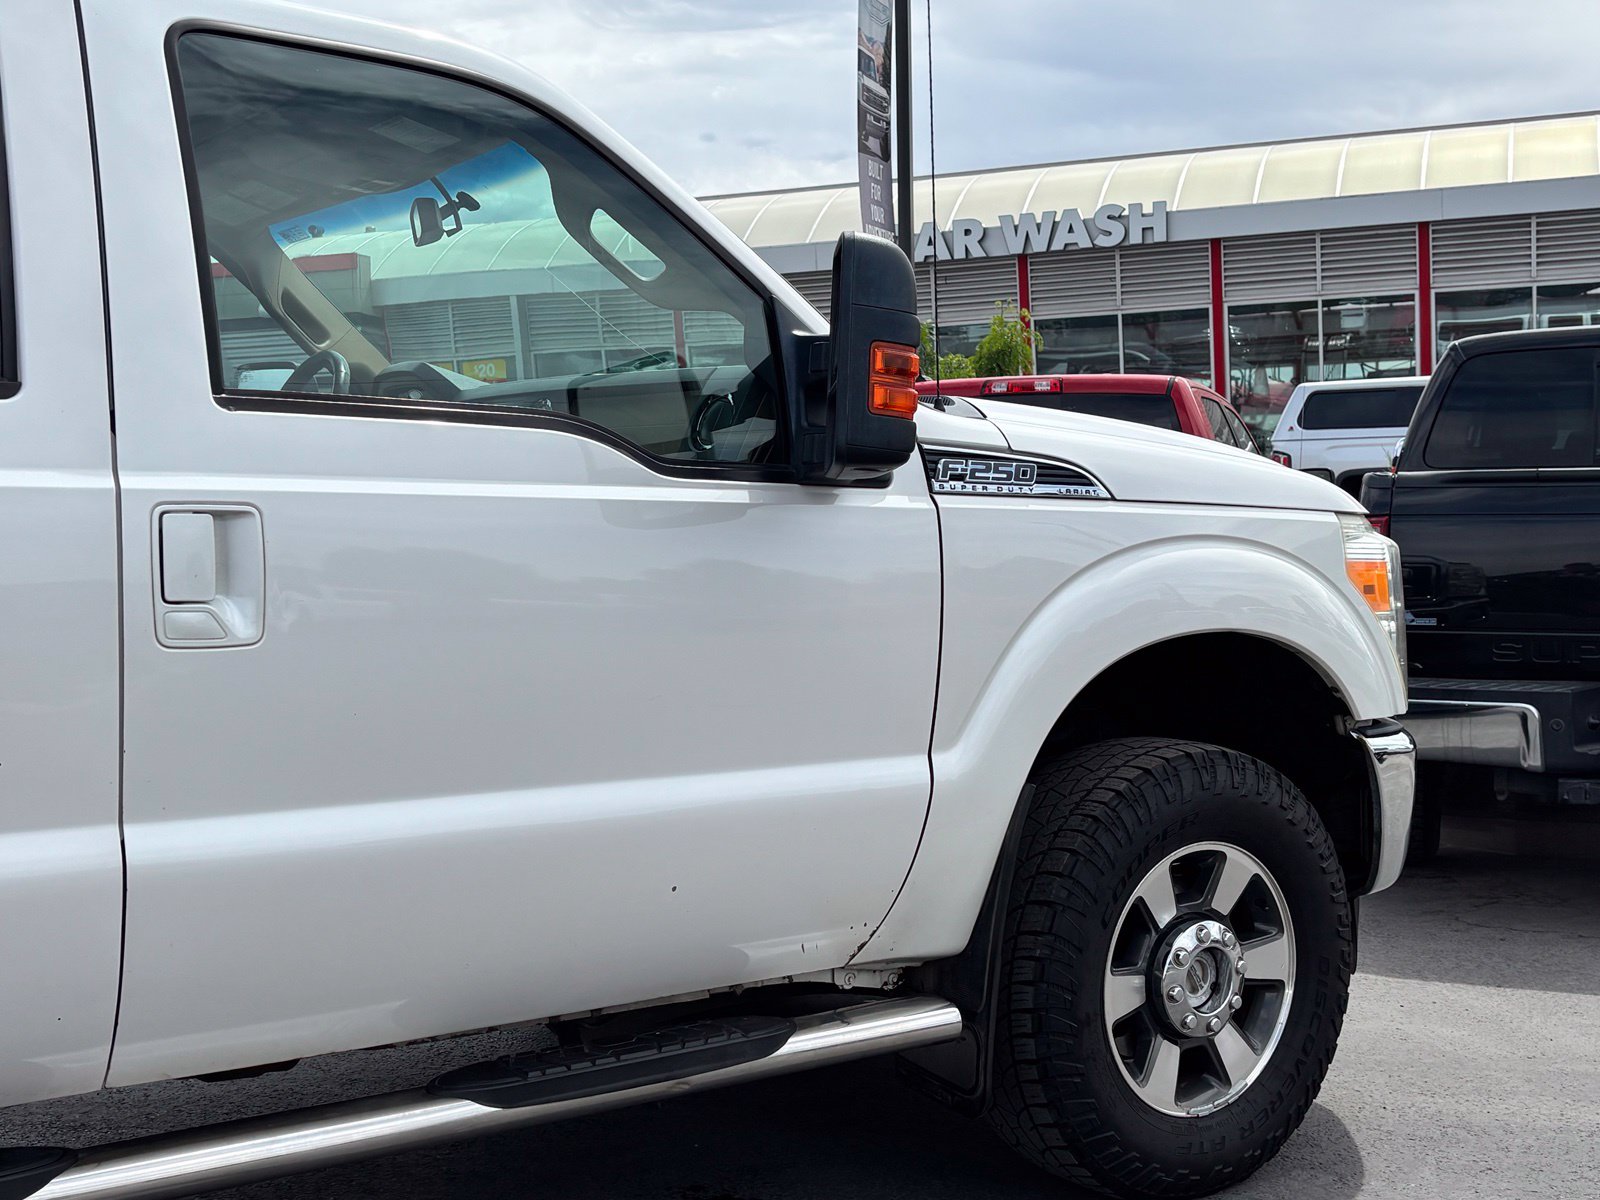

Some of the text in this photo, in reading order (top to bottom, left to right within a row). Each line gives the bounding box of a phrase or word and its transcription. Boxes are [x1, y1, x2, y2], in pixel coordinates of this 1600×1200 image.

[868, 159, 883, 181] BUILT
[871, 182, 882, 202] FOR
[870, 203, 885, 224] YOUR
[914, 200, 1167, 262] AR WASH
[473, 362, 496, 378] $20
[935, 458, 1038, 486] F-250
[938, 483, 1098, 496] SUPER DUTY LARIAT
